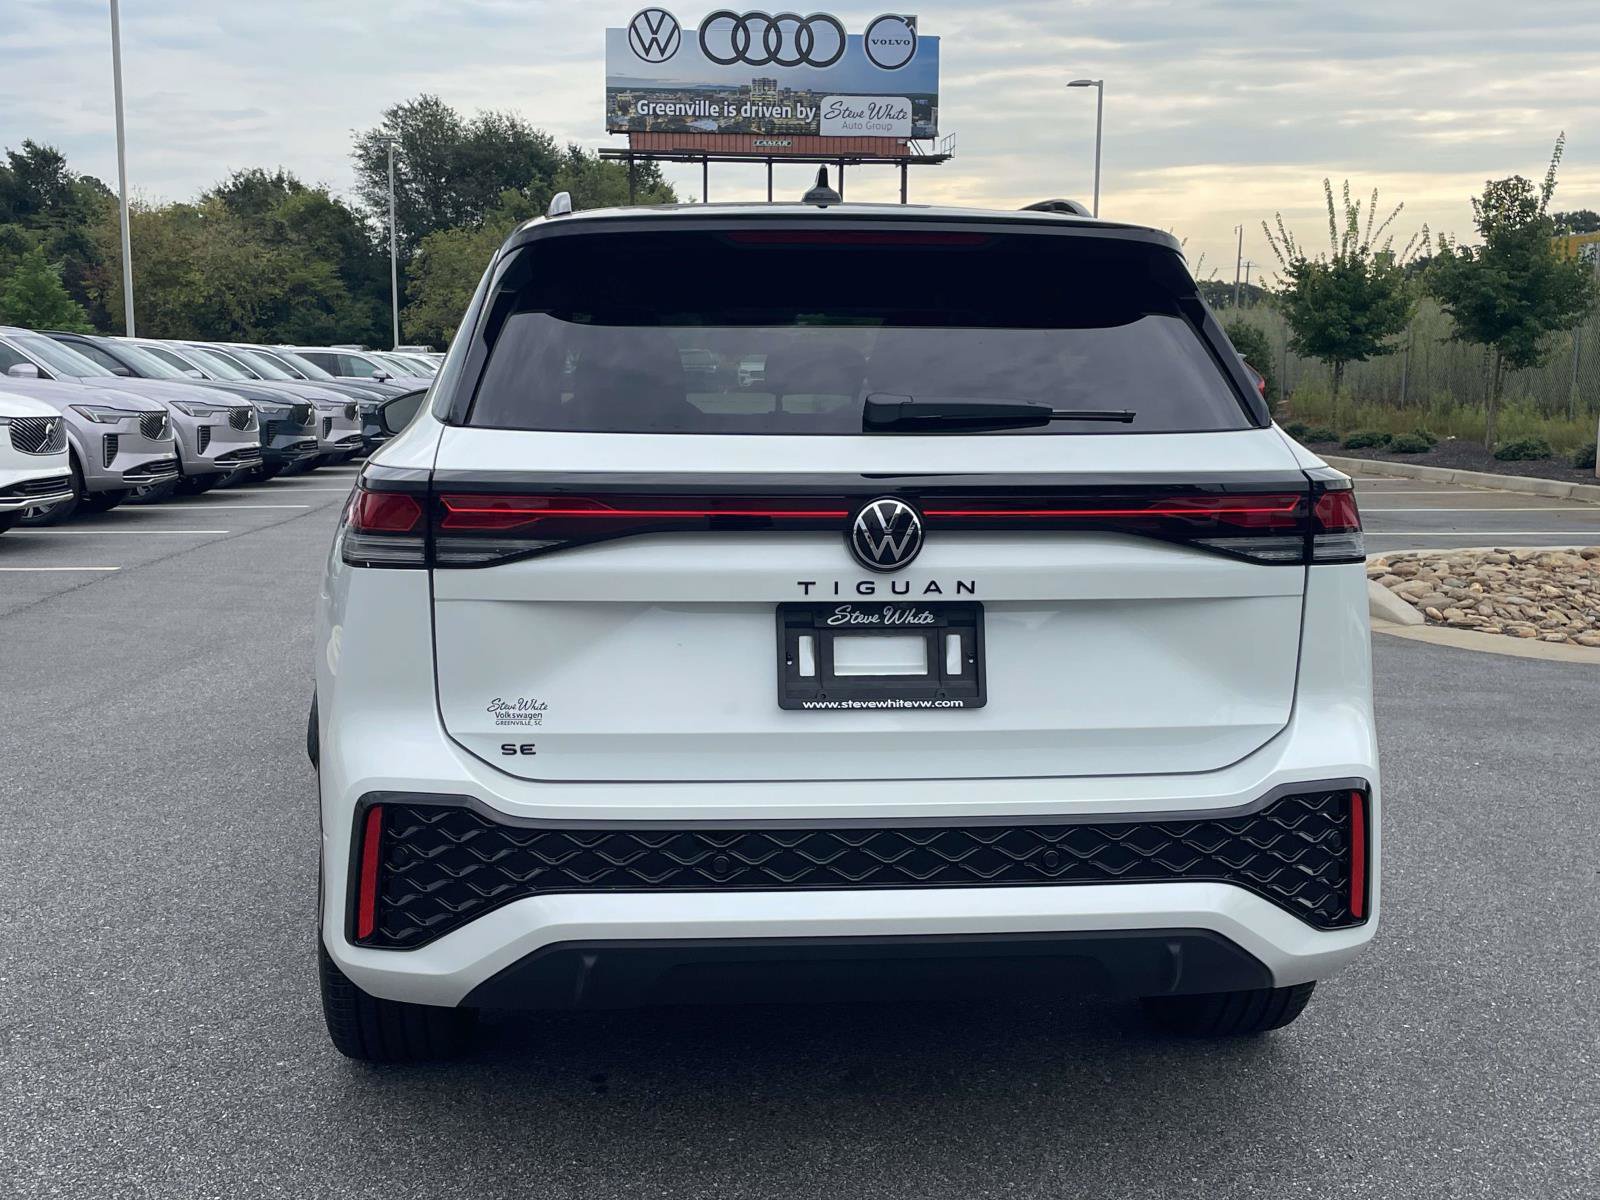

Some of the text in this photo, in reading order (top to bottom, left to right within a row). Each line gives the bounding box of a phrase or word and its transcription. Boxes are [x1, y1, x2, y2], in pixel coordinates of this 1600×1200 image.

[637, 100, 816, 123] Greenville is driven by
[823, 100, 909, 121] Steve White
[841, 121, 893, 131] Auto Group
[797, 580, 976, 596] TIGUAN
[827, 604, 935, 625] Steve White
[486, 697, 549, 713] Steve White
[802, 699, 964, 709] www.stevewhitevw.com
[495, 711, 542, 720] Volkswagen
[501, 743, 536, 756] SE
